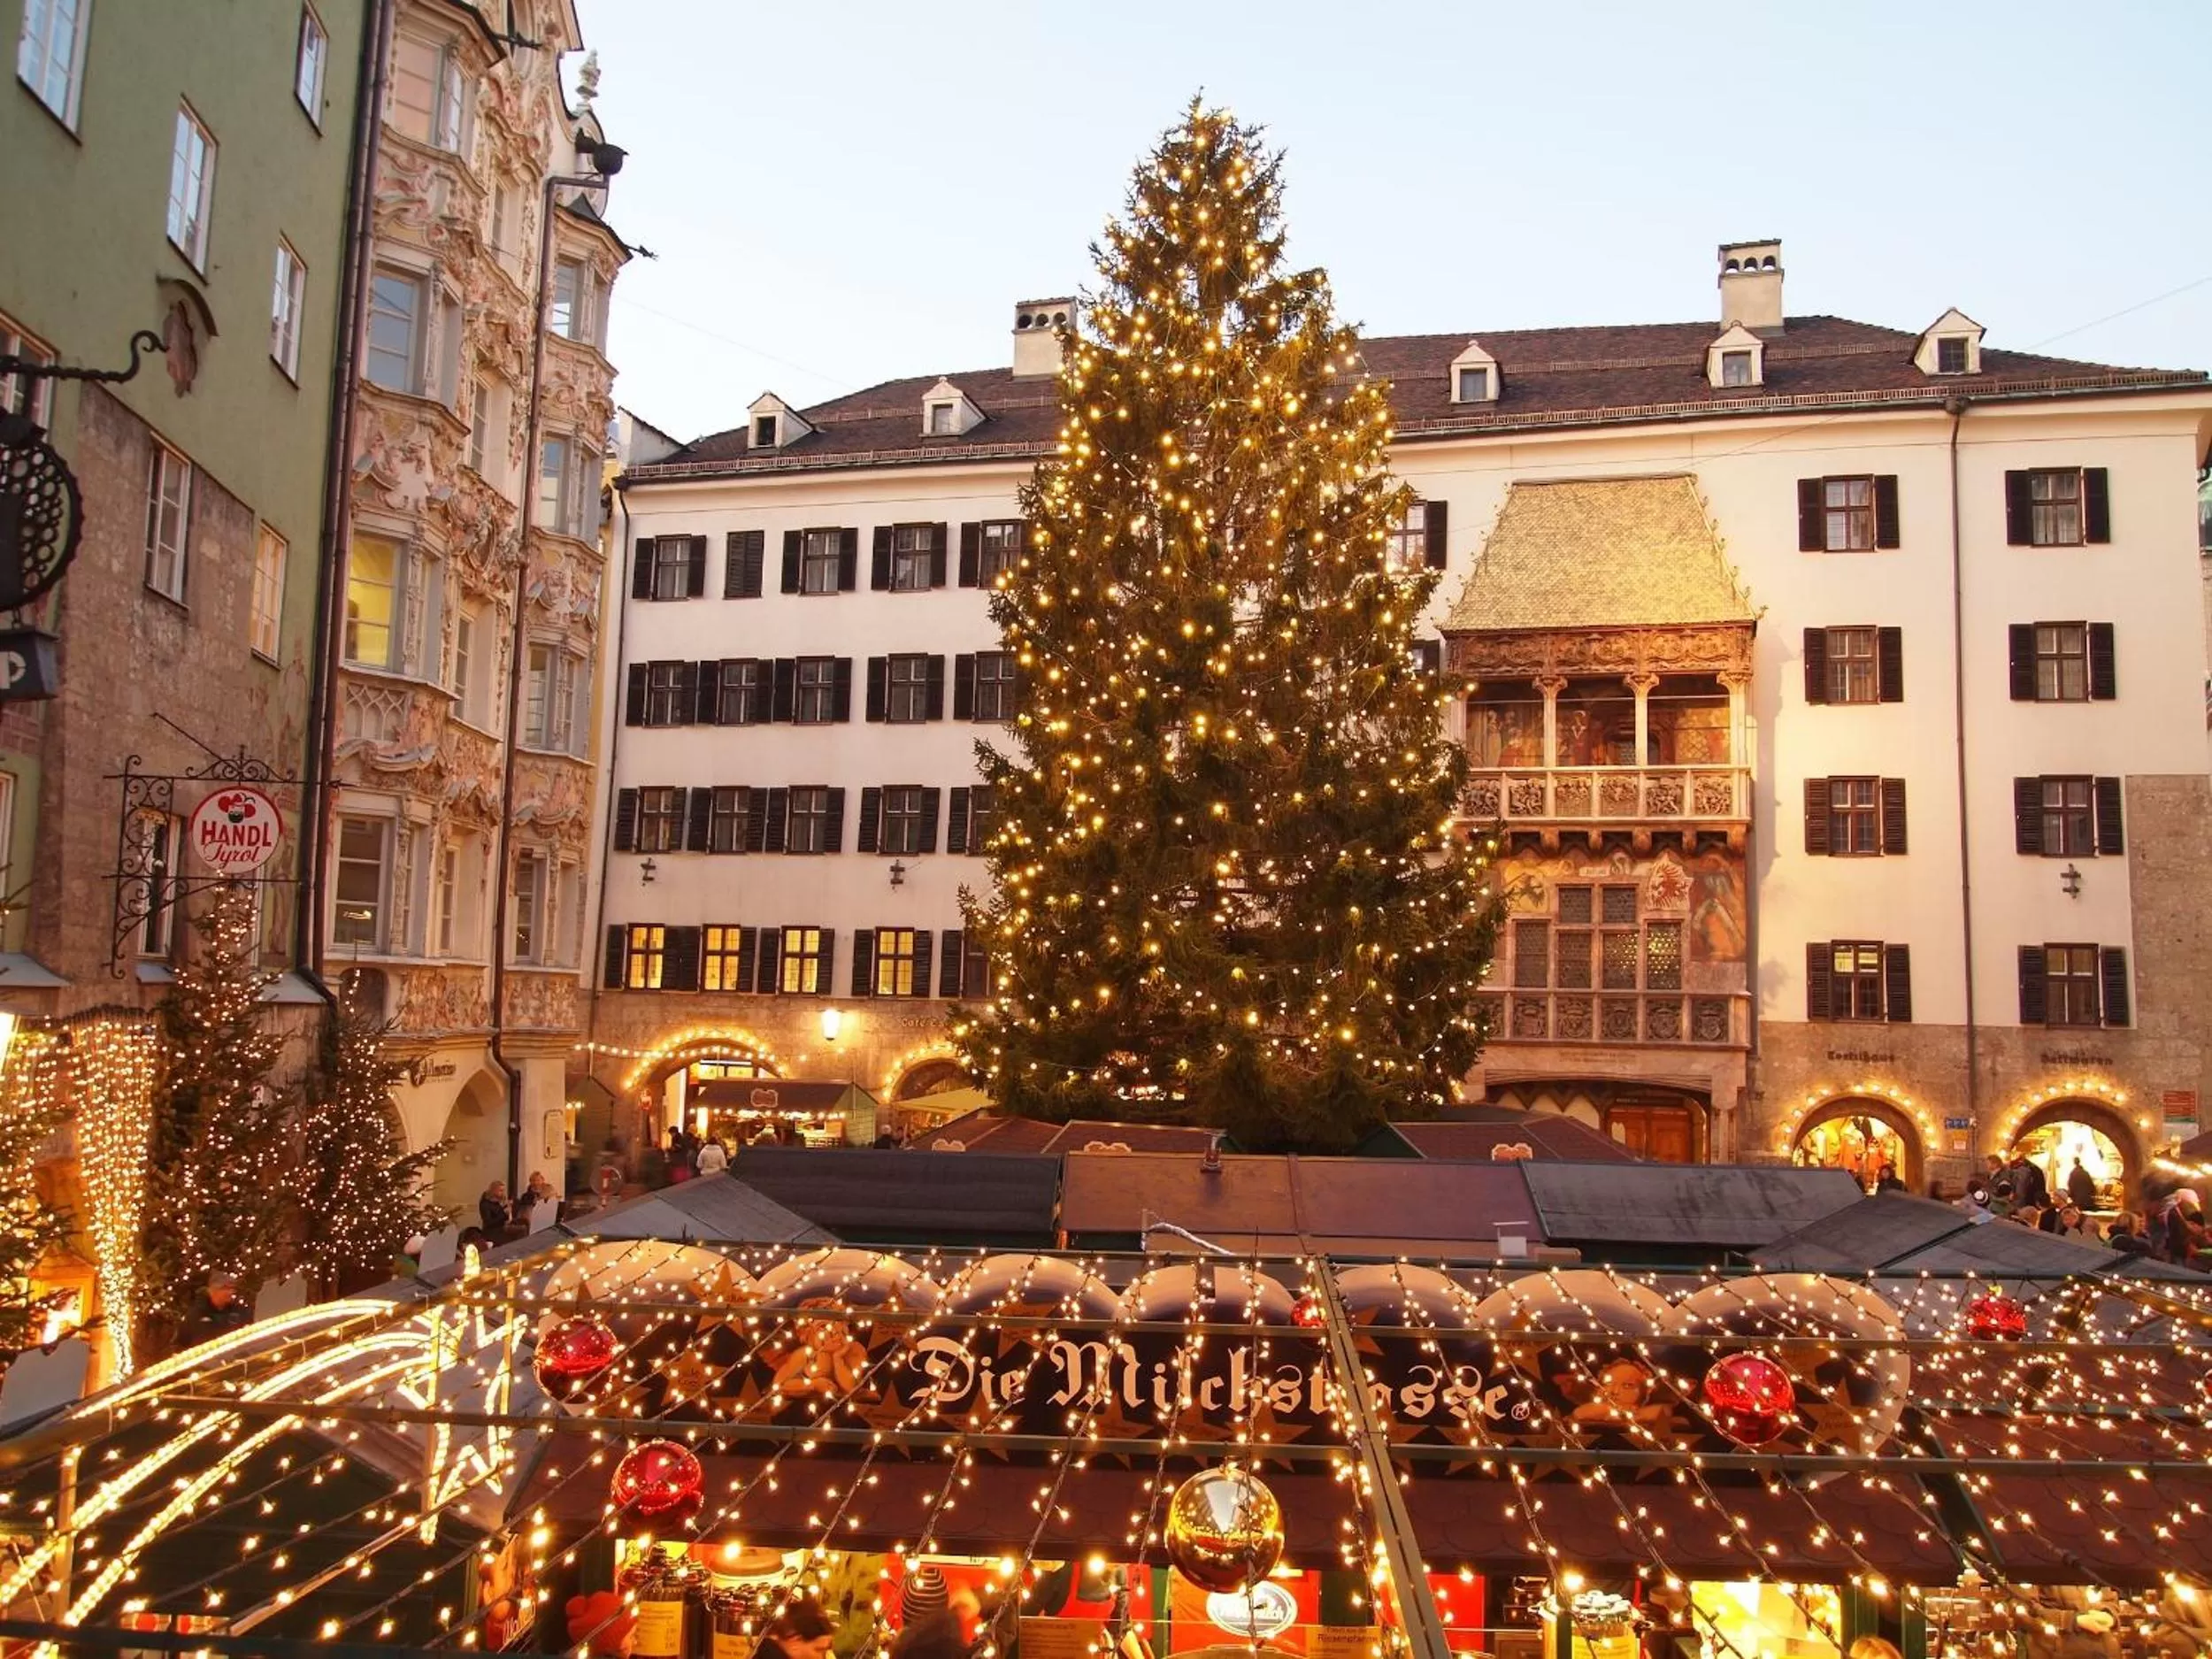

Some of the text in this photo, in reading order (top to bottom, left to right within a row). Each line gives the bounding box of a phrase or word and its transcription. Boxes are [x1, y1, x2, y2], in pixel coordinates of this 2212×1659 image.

[201, 819, 272, 847] HANDL
[204, 838, 260, 869] Tyrol
[908, 1336, 1509, 1419] Die Milchstasse
